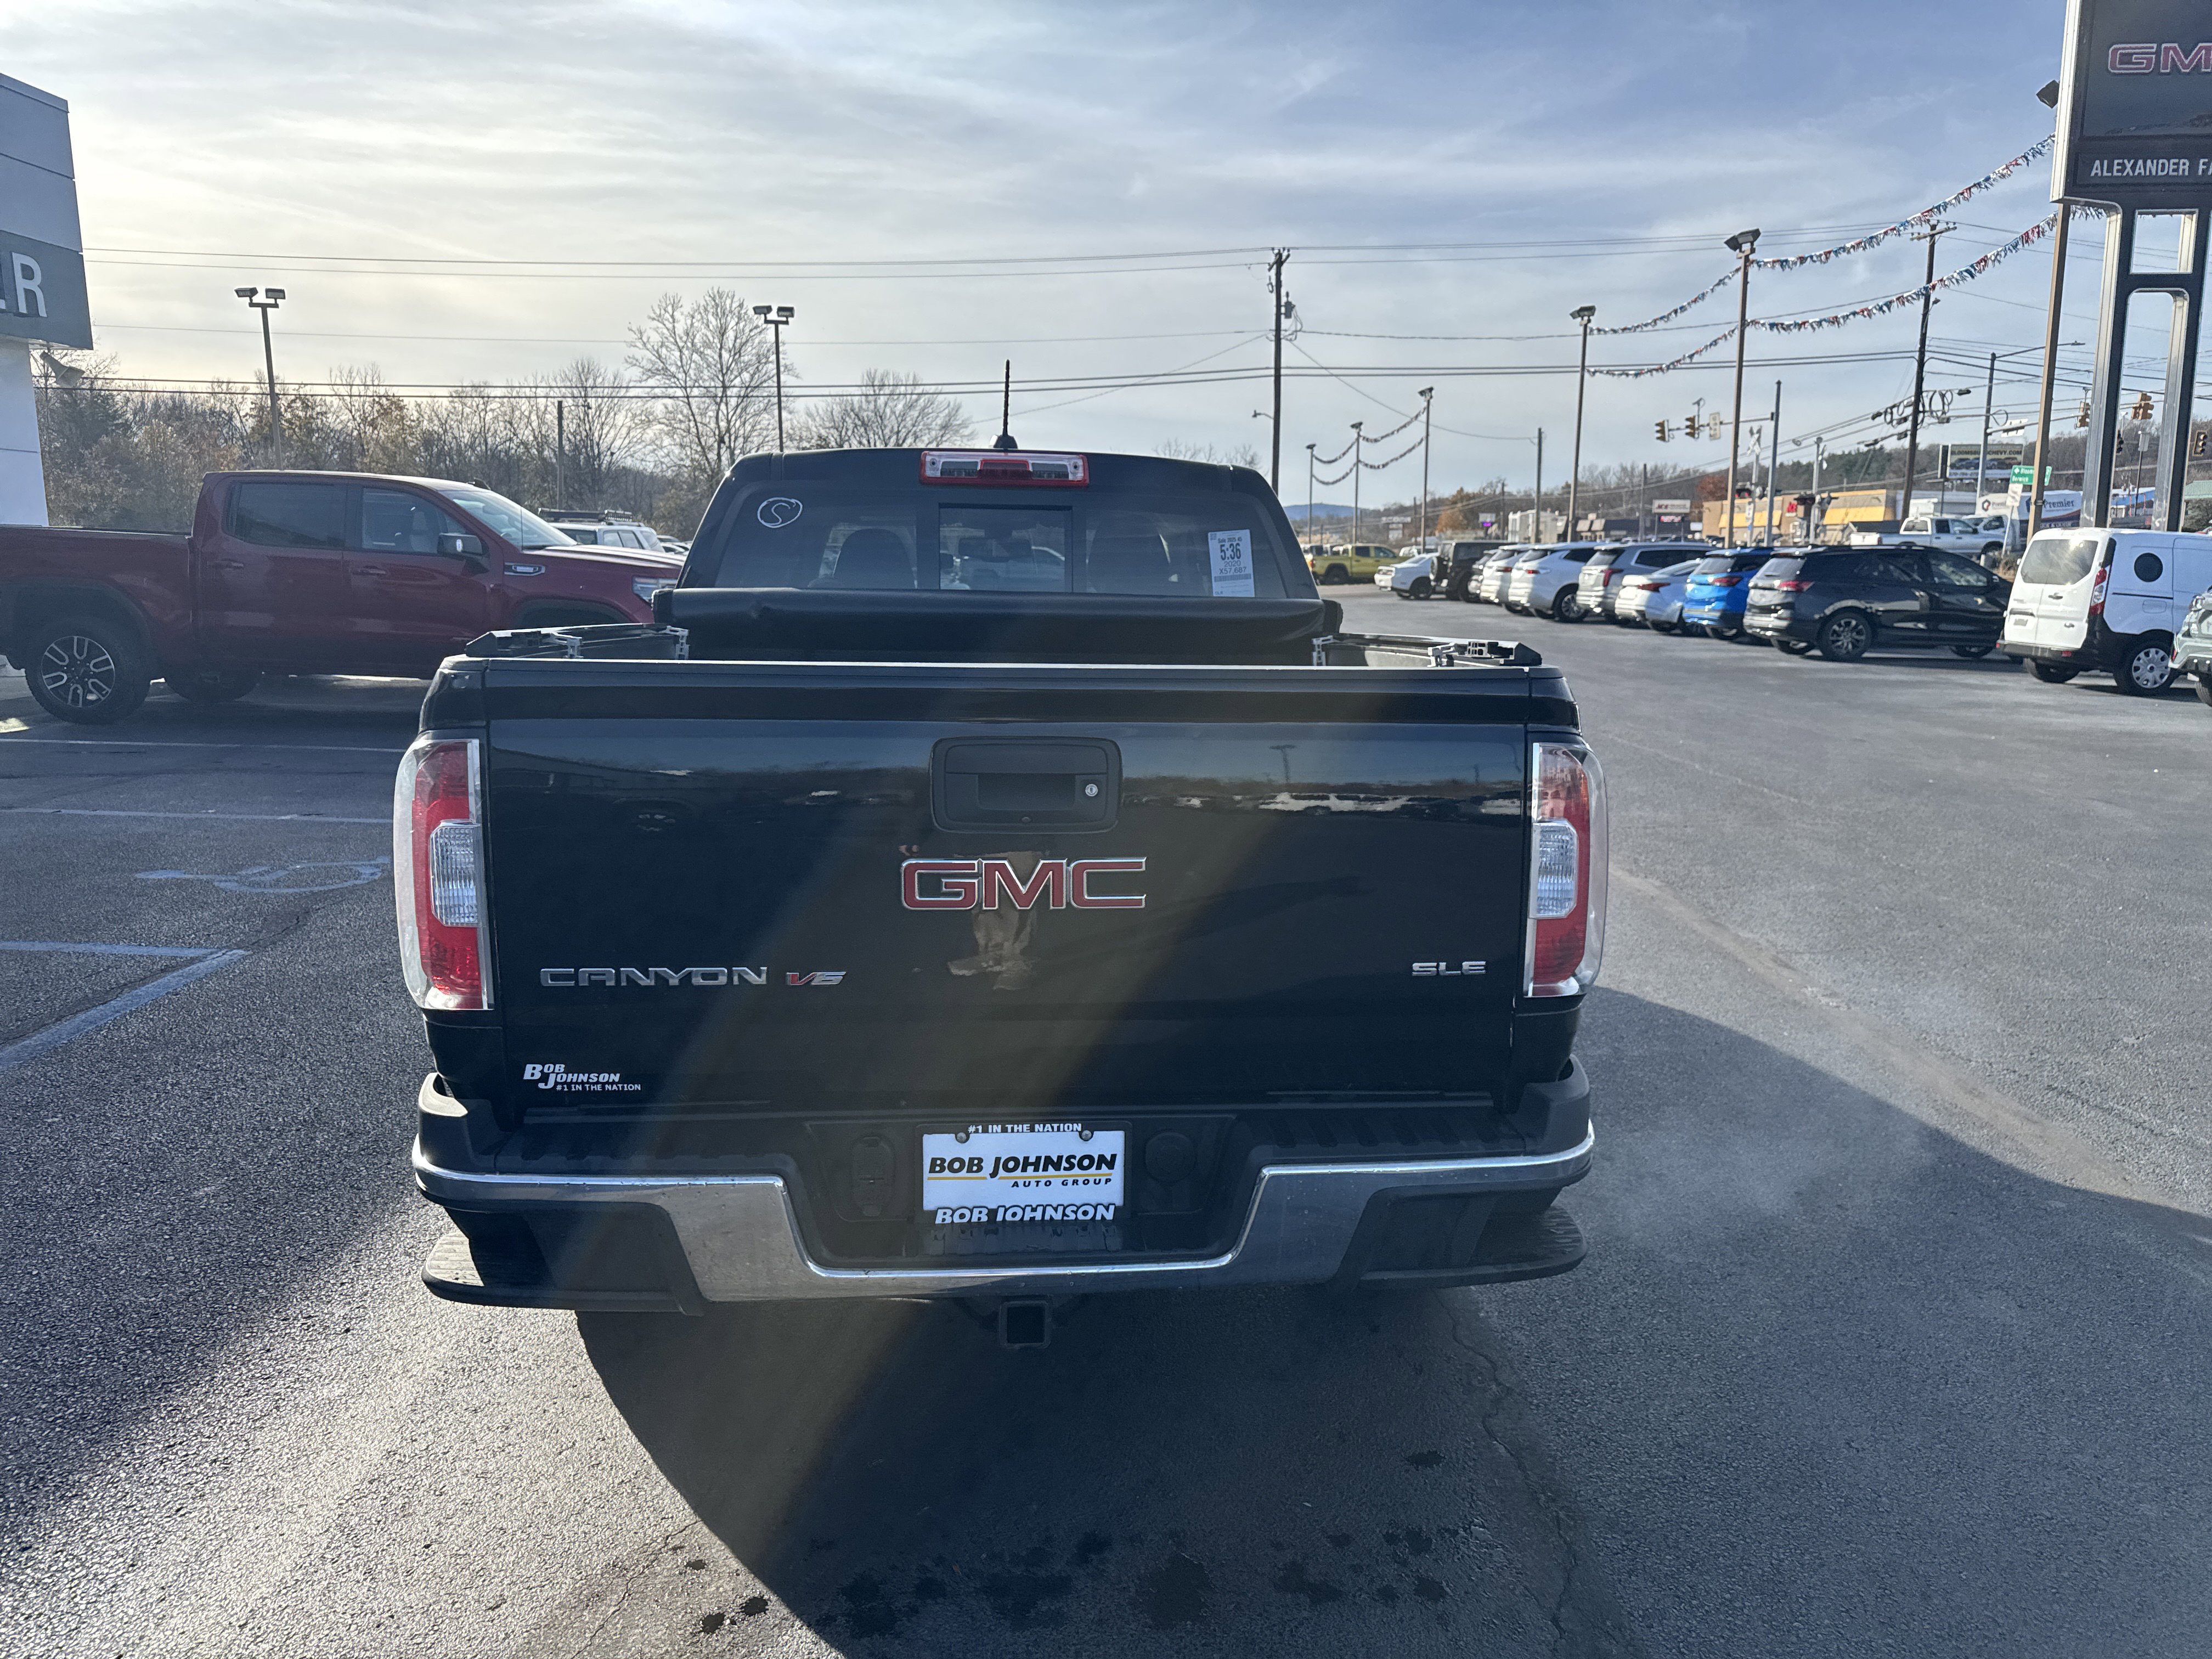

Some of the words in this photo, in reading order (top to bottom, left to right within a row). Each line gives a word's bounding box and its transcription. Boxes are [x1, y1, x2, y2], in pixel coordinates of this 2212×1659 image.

[2090, 159, 2190, 177] ALEXANDER
[2198, 158, 2212, 175] F
[0, 252, 48, 318] R
[2044, 499, 2074, 509] Premier
[1220, 543, 1241, 561] 5:36
[901, 858, 1147, 910] GMC
[540, 967, 767, 986] CANYON
[786, 971, 847, 985] V6
[1412, 961, 1486, 976] SLE
[538, 1073, 620, 1089] JOHNSON
[988, 1125, 1001, 1133] IN
[1006, 1124, 1030, 1133] THE
[1035, 1124, 1082, 1132] NATION
[929, 1157, 984, 1173] BOB
[989, 1154, 1118, 1178] JOHNSON
[1011, 1180, 1052, 1188] AUTO
[1062, 1178, 1112, 1187] GROUP
[935, 1207, 988, 1224] BOB
